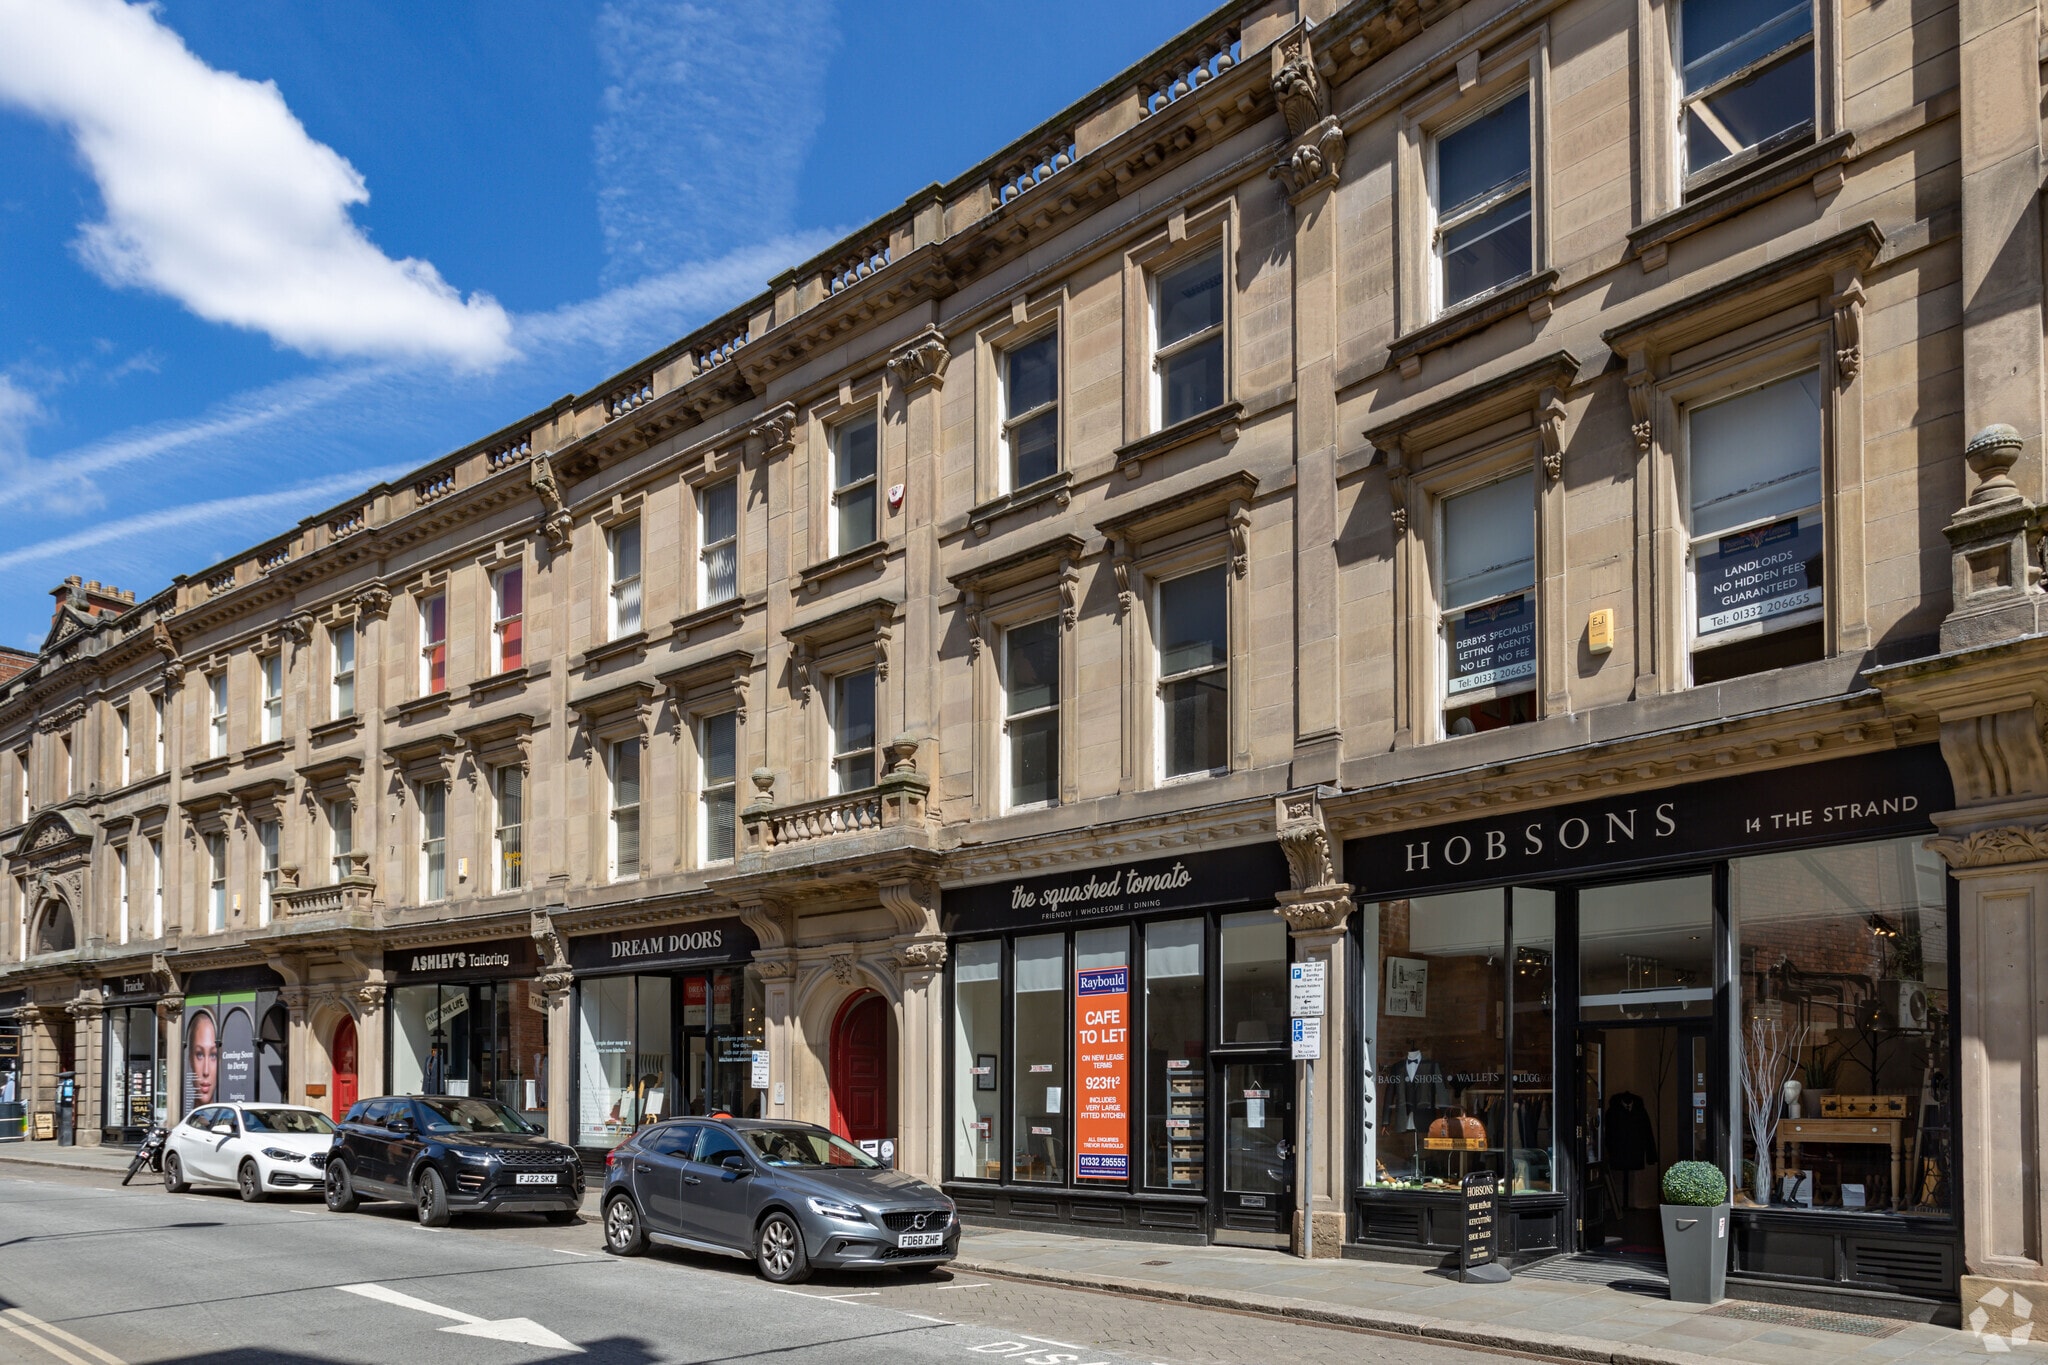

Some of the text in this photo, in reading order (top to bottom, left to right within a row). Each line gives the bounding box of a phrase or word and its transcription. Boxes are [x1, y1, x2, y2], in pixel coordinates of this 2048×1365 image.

[1725, 551, 1793, 577] LANDLORDS
[1713, 561, 1806, 594] NO HIDDEN FEES
[1722, 578, 1798, 605] GUARANTEED
[1711, 593, 1810, 626] Tel: 01332 206655
[1456, 622, 1534, 650] DERBYS SPECIALIST
[1459, 635, 1531, 660] LETTING AGENTS
[1460, 648, 1530, 672] NO LET NO FEE
[1458, 663, 1532, 688] Tel: 01332 206655
[1746, 796, 1918, 833] 14 THE STRAND
[1405, 803, 1677, 872] HOBSONS
[1011, 862, 1192, 912] the squashed tomato
[1041, 899, 1161, 920] FRIENDLY WHOLESOME DINING
[611, 929, 722, 958] DREAM DOORS
[411, 952, 509, 971] ASHLEY'S Tailoring
[1081, 973, 1125, 990] Raybould
[453, 998, 465, 1010] LIFE
[1085, 1009, 1120, 1025] CAFE
[1080, 1028, 1126, 1044] TO LET
[222, 1051, 240, 1060] Coming
[233, 1061, 248, 1071] Derby
[1378, 1075, 1401, 1084] BAGS
[1414, 1074, 1443, 1083] SHOES
[1456, 1072, 1499, 1082] WALLETS
[1081, 1157, 1126, 1166] 01332 295555
[1467, 1184, 1494, 1197] HOBSONS
[902, 1234, 940, 1245] FD68 ZHF
[1479, 1230, 1491, 1239] SALES
